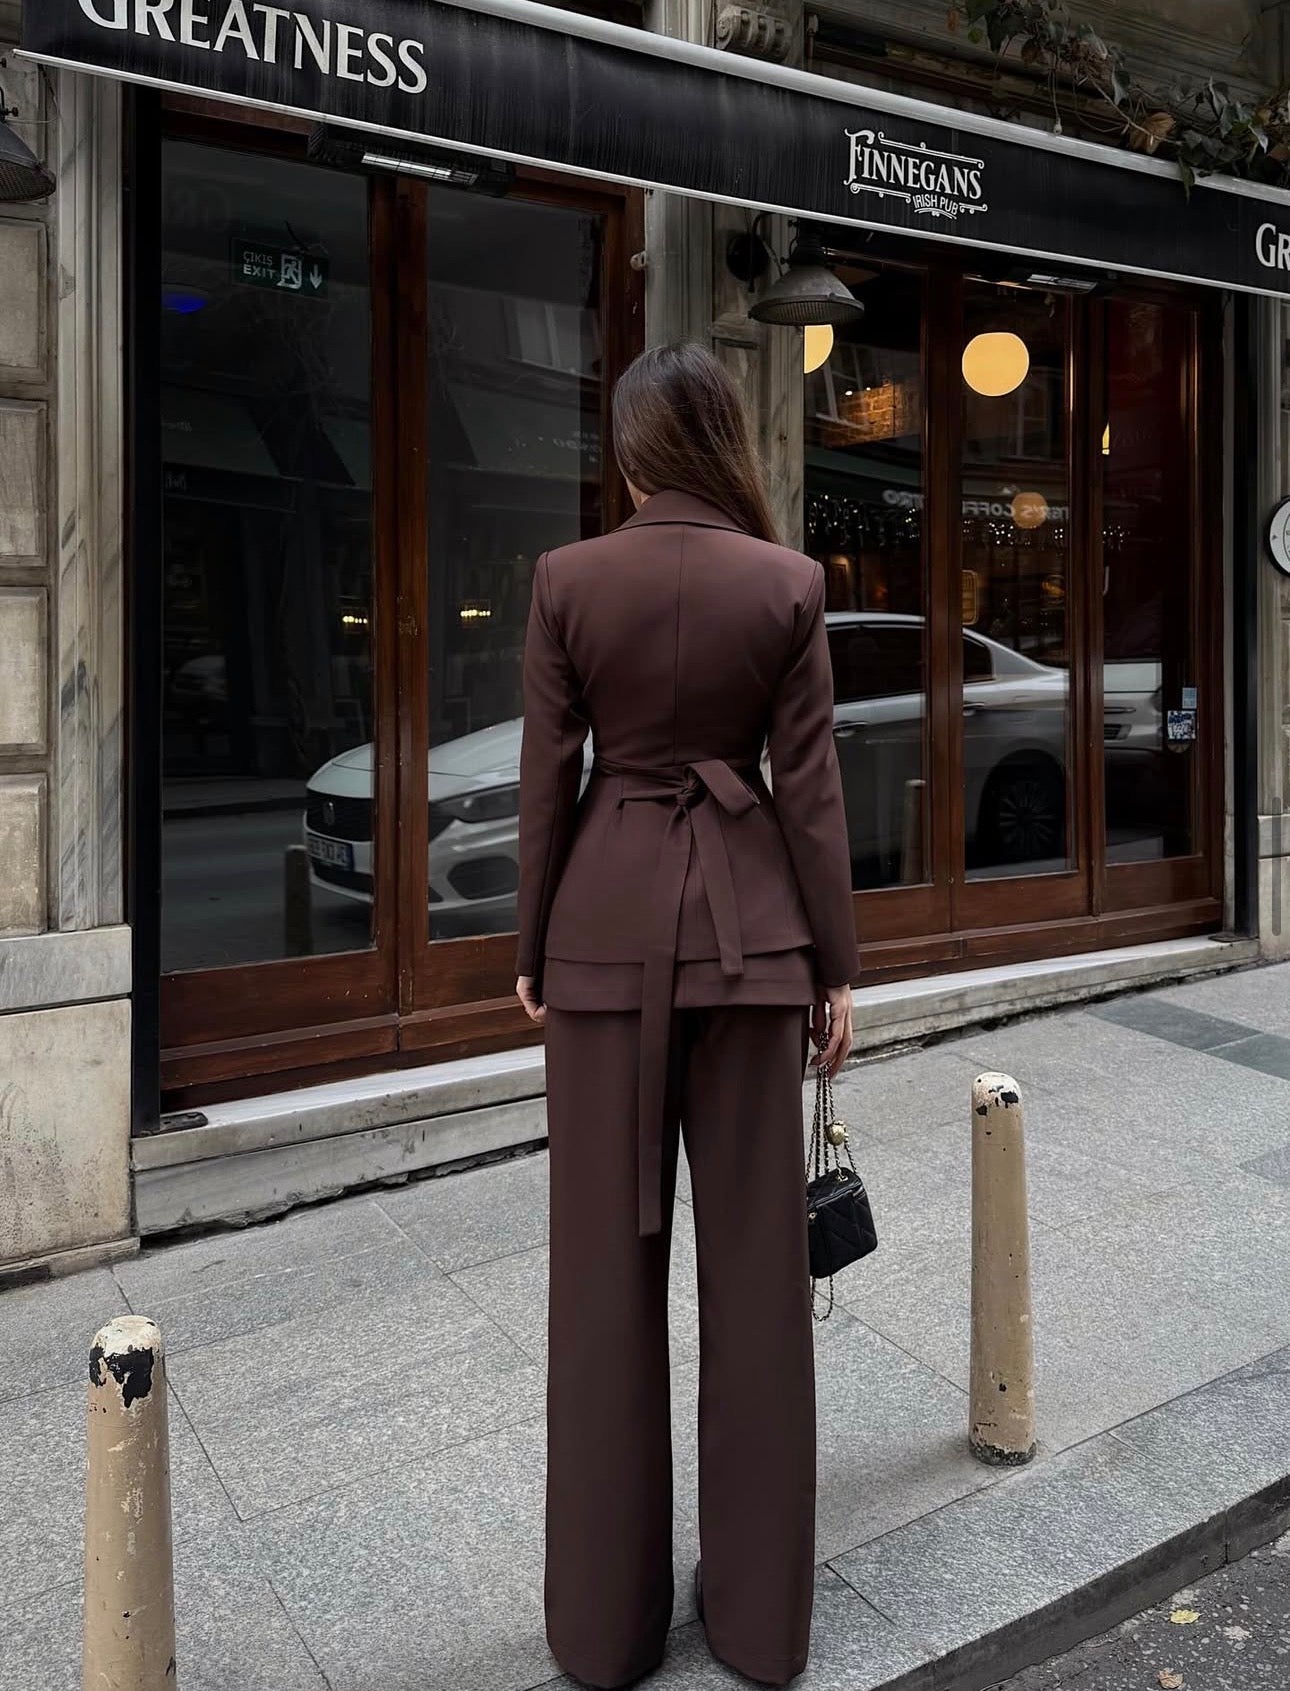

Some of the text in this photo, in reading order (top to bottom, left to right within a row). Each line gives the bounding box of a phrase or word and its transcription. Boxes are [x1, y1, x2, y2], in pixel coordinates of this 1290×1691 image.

[843, 128, 982, 200] FINNEGANS
[912, 193, 959, 215] IRISH PUB
[243, 264, 276, 279] EXIT
